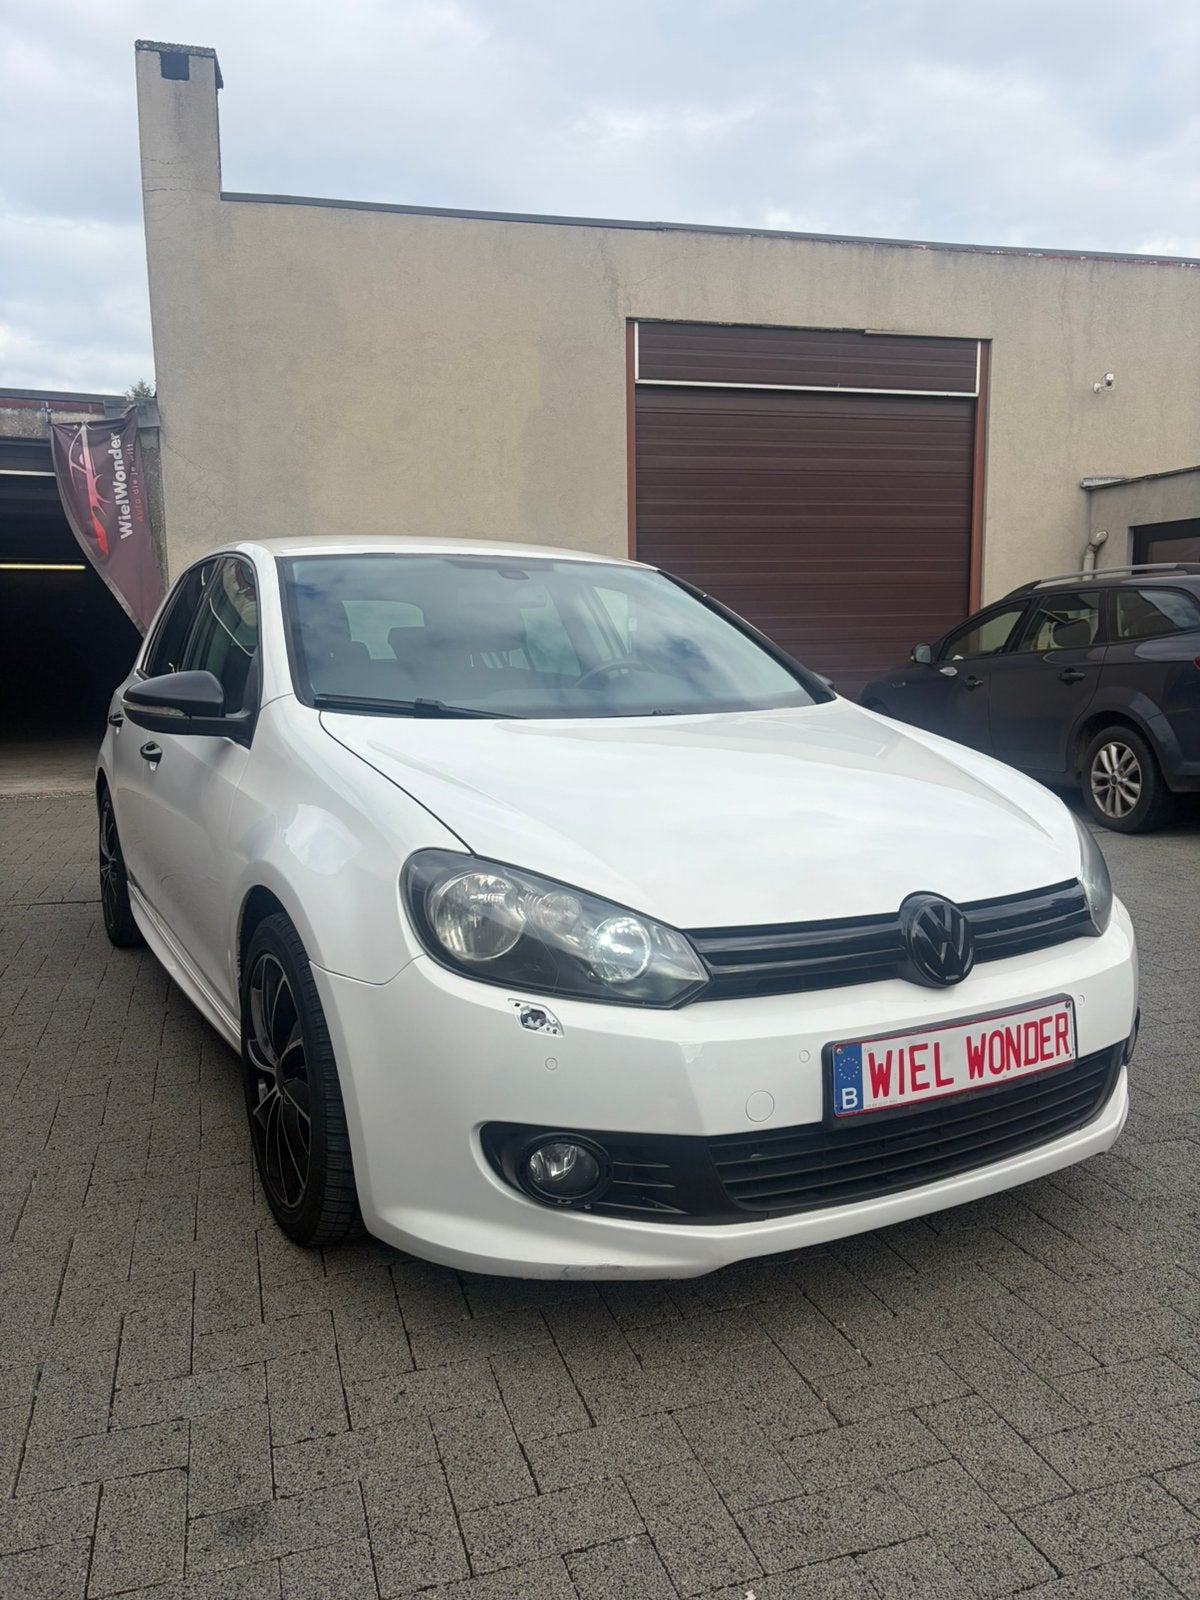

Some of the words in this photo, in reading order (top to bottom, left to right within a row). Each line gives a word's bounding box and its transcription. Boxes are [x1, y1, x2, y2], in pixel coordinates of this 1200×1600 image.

[108, 432, 133, 540] WielWonder
[841, 1087, 858, 1110] B
[867, 1041, 954, 1099] WIEL
[965, 1011, 1070, 1080] WONDER
